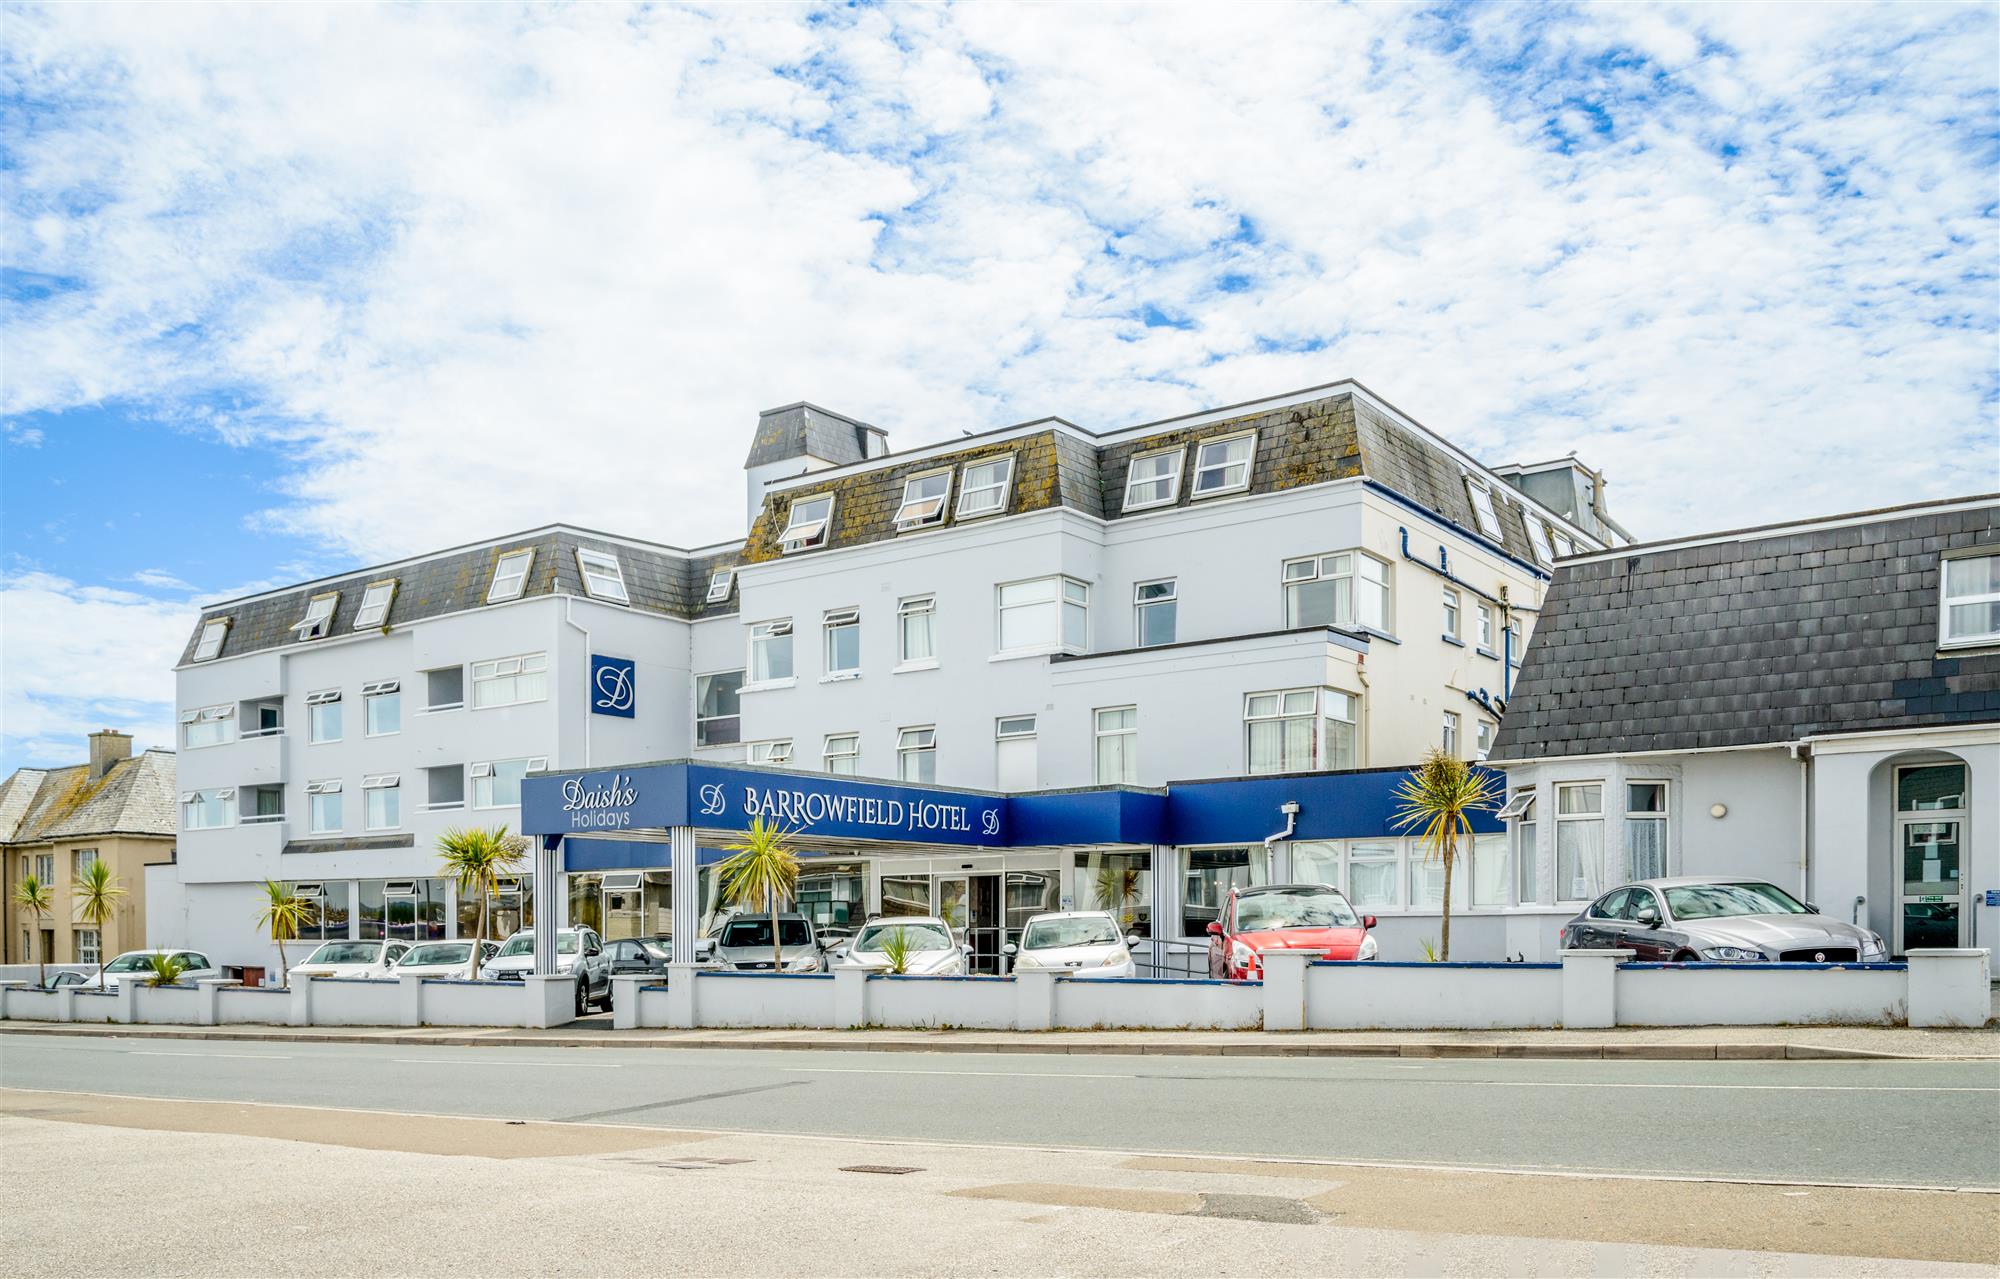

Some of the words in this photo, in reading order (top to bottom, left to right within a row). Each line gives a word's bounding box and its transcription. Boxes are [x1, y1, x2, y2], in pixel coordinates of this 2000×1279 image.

[562, 774, 639, 811] Daish's
[743, 787, 904, 826] BARROWFIELD
[908, 799, 971, 832] HOTEL
[571, 810, 630, 829] Holidays
